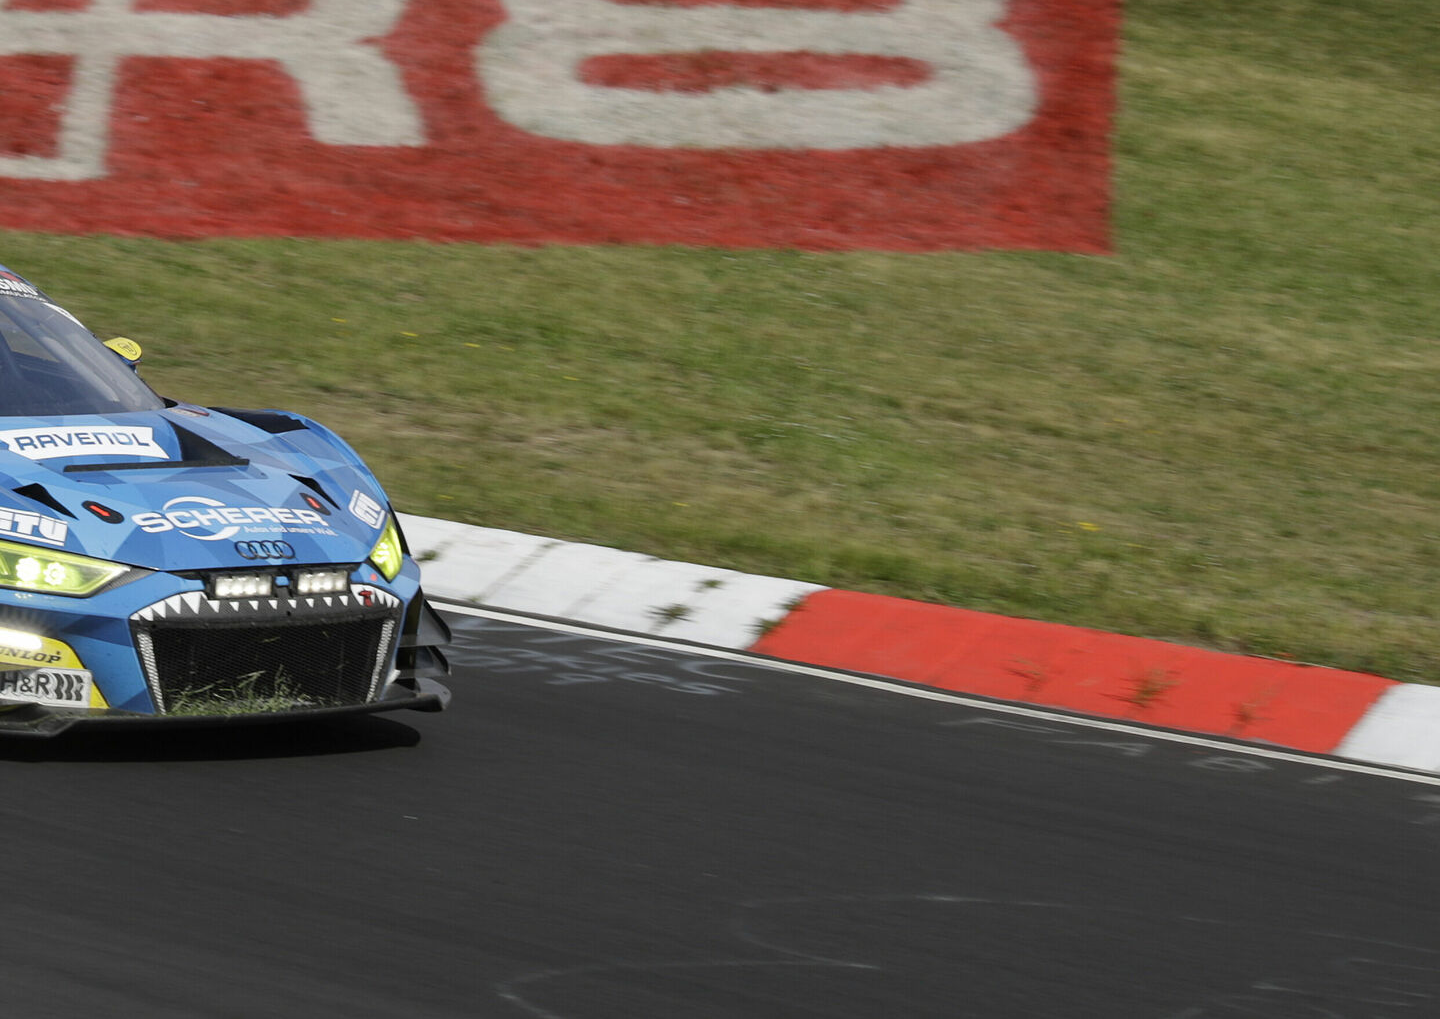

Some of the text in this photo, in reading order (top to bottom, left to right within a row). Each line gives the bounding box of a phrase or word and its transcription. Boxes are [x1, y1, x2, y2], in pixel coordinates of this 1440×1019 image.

[13, 432, 150, 451] RAVENOL
[130, 506, 330, 534] SCHERER
[0, 670, 51, 696] H&R
